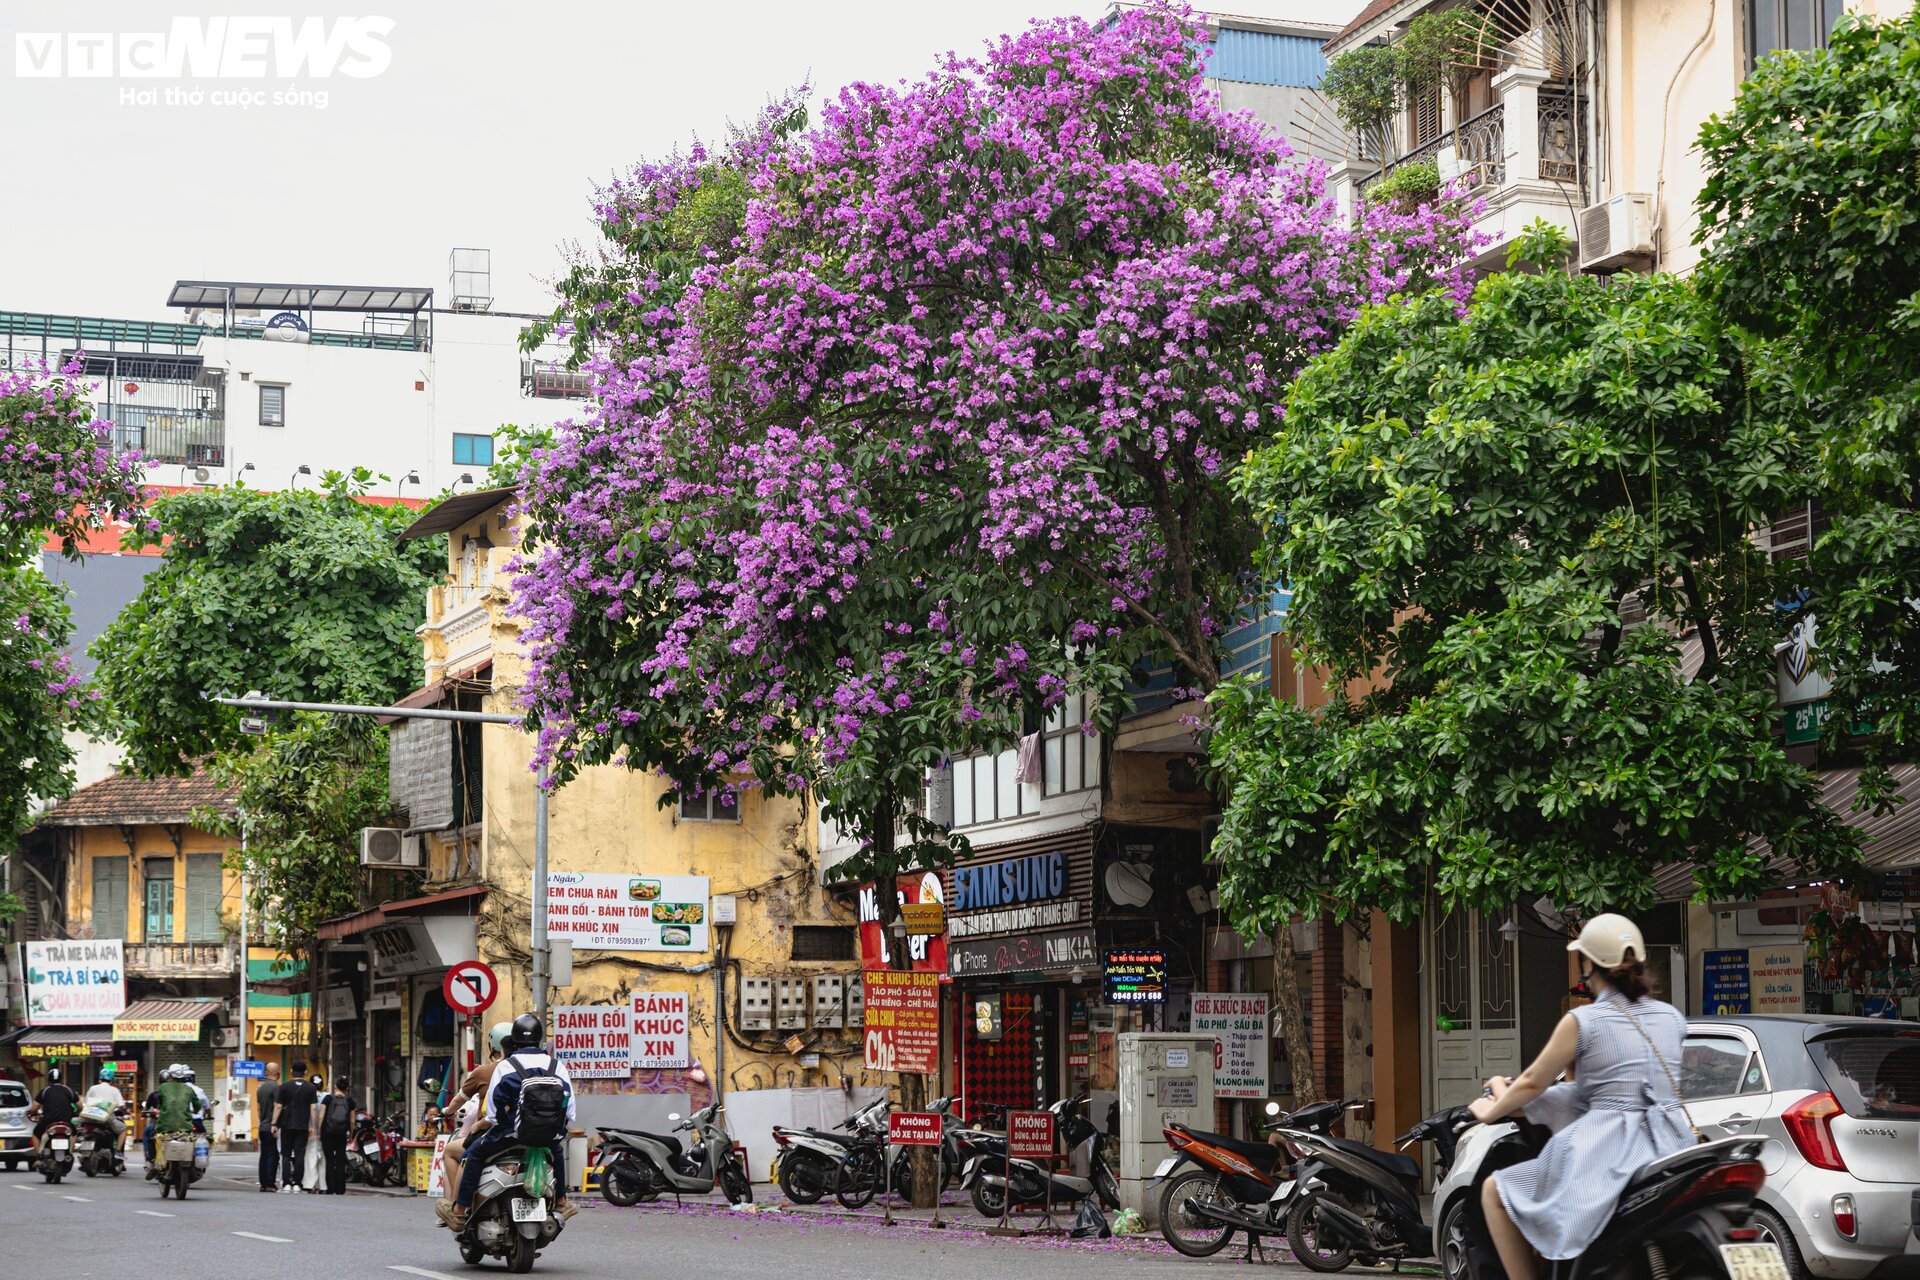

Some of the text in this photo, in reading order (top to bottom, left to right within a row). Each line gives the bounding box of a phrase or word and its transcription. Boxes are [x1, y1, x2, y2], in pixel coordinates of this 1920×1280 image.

[954, 850, 1066, 911] SAMSUNG
[568, 887, 594, 899] CHUA
[597, 886, 618, 899] RÁN
[547, 901, 649, 918] ÁNH GỐI BÁNH TÔM
[547, 919, 619, 936] ÁNH KHÚC XỊN
[46, 943, 65, 962] TRÀ
[67, 946, 82, 961] ME
[963, 935, 1093, 970] iPhone NOKIA
[47, 966, 74, 986] TRÀ
[76, 966, 89, 985] BÍ
[633, 993, 683, 1013] BÁNH
[1194, 995, 1211, 1015] CHÈ
[1213, 995, 1238, 1015] KHÚC
[1241, 999, 1266, 1018] BẠCH
[558, 1007, 626, 1029] BÁNH GỐI
[633, 1015, 685, 1035] KHÚC
[116, 1021, 137, 1032] NƯỚC
[139, 1023, 159, 1034] NGỌT
[255, 1025, 277, 1041] 15
[555, 1029, 629, 1049] BÁNH TÔM
[556, 1049, 629, 1059] NEM CHUA RÁN
[644, 1040, 674, 1060] XỊN
[865, 1029, 896, 1072] Chè
[566, 1059, 629, 1070] ÁNH KHÚC
[1222, 1078, 1242, 1086] LONG
[900, 1116, 931, 1127] KHÔNG
[1015, 1115, 1047, 1128] KHÔNG
[902, 1130, 911, 1139] XE
[912, 1130, 923, 1141] TẠI
[924, 1129, 939, 1140] ĐÂY
[1040, 1132, 1047, 1140] XE
[1856, 1127, 1898, 1139] morning
[1035, 1143, 1041, 1151] RA
